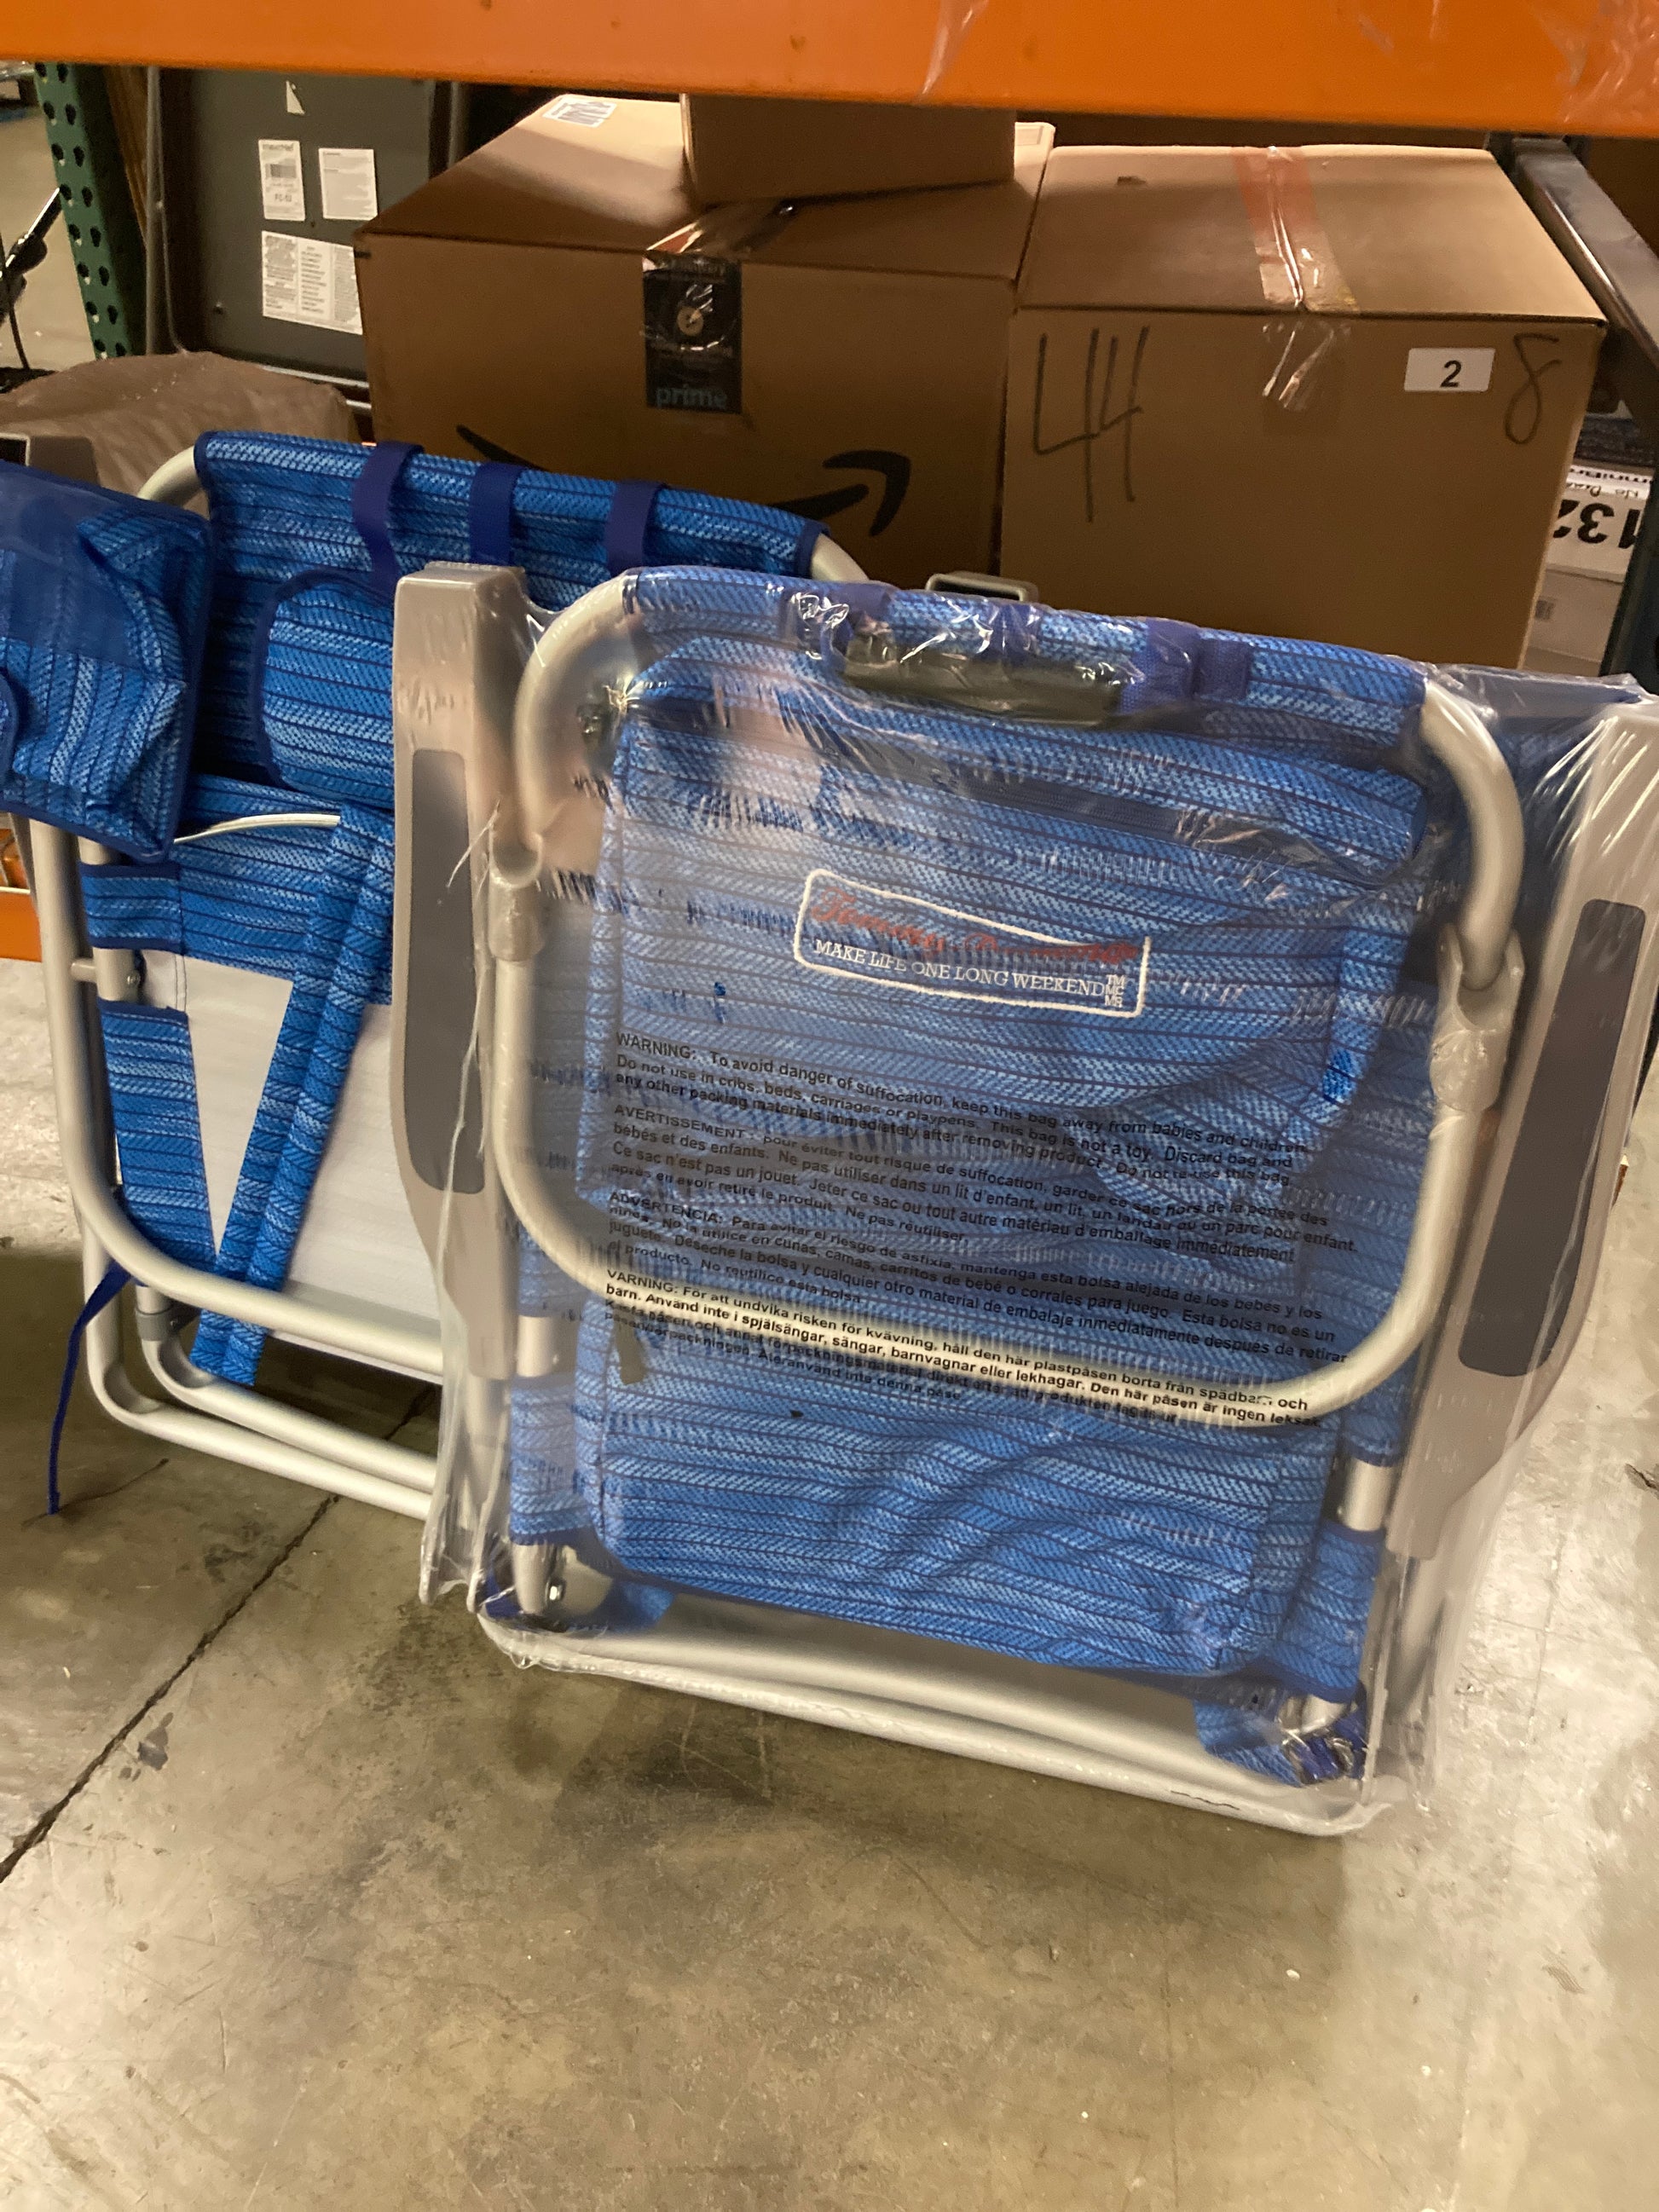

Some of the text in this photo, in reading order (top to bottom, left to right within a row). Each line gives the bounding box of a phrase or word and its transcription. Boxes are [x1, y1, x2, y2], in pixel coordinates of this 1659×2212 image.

[656, 385, 727, 409] prime
[1440, 360, 1462, 388] 2
[812, 939, 1105, 996] MAKE LIFE ONE LONG WEEKEND
[616, 1032, 1235, 1146] WARNING: To avoid danger of keep this bag away from babies and
[616, 1054, 1292, 1170] Do not use in carriages or This bag is not Discard bag and
[616, 1072, 1035, 1159] any other packing materials immediately after removing
[612, 1141, 997, 1226] Ce sac n'est pas un Jeter ce sac ou tout autre
[613, 1103, 746, 1139] AVERTISSEMENT
[763, 1135, 797, 1148] pour
[848, 1147, 880, 1164] tout
[883, 1153, 931, 1173] risque
[935, 1159, 954, 1175] de
[1052, 1184, 1105, 1203] garder
[1108, 1194, 1127, 1208] ce
[1132, 1201, 1161, 1216] sac
[1165, 1202, 1201, 1215] hors
[1205, 1199, 1225, 1213] de
[662, 1132, 1300, 1240] et des Ne pas utiliser dans un lit un un landau un parc pour
[676, 1174, 894, 1226] avoir Ne pas
[673, 1231, 1348, 1363] Deseche la bolsa cualquier otro material de embalaje inmediatamente de retirar
[701, 1225, 747, 1242] utilice
[751, 1233, 770, 1245] en
[879, 1262, 938, 1281] carritos
[941, 1269, 961, 1285] de
[1020, 1286, 1083, 1306] corrales
[1087, 1297, 1122, 1311] para
[1181, 1307, 1215, 1325] Esta
[1218, 1314, 1262, 1331] bolsa
[1266, 1323, 1287, 1334] no
[1291, 1325, 1310, 1337] es
[1314, 1329, 1335, 1342] un
[731, 1213, 766, 1231] Para
[770, 1220, 809, 1235] evitar
[813, 1227, 826, 1240] el
[830, 1230, 876, 1254] riesgo
[879, 1241, 897, 1257] de
[959, 1260, 1036, 1282] mantenga
[1040, 1271, 1072, 1285] esta
[1077, 1273, 1120, 1290] bolsa
[1125, 1279, 1179, 1300] alejada
[1182, 1288, 1201, 1303] de
[1205, 1291, 1229, 1308] los
[1298, 1303, 1323, 1320] los
[606, 1266, 1308, 1410] VARNING: För att undvika risken för kvävning, håll den här plastpåsen borta från och
[606, 1281, 640, 1301] barn.
[645, 1291, 698, 1312] Använd
[702, 1302, 729, 1319] inte
[741, 1315, 827, 1345] spjälsängar,
[831, 1334, 886, 1356] sängar,
[890, 1344, 976, 1372] barnvagnar
[980, 1363, 1012, 1379] eller
[1015, 1368, 1084, 1391] lekhagar.
[1090, 1380, 1119, 1396] Den
[1124, 1385, 1148, 1401] här
[1152, 1392, 1198, 1409] påsen
[1202, 1399, 1218, 1413] är
[1222, 1402, 1265, 1423] ingen
